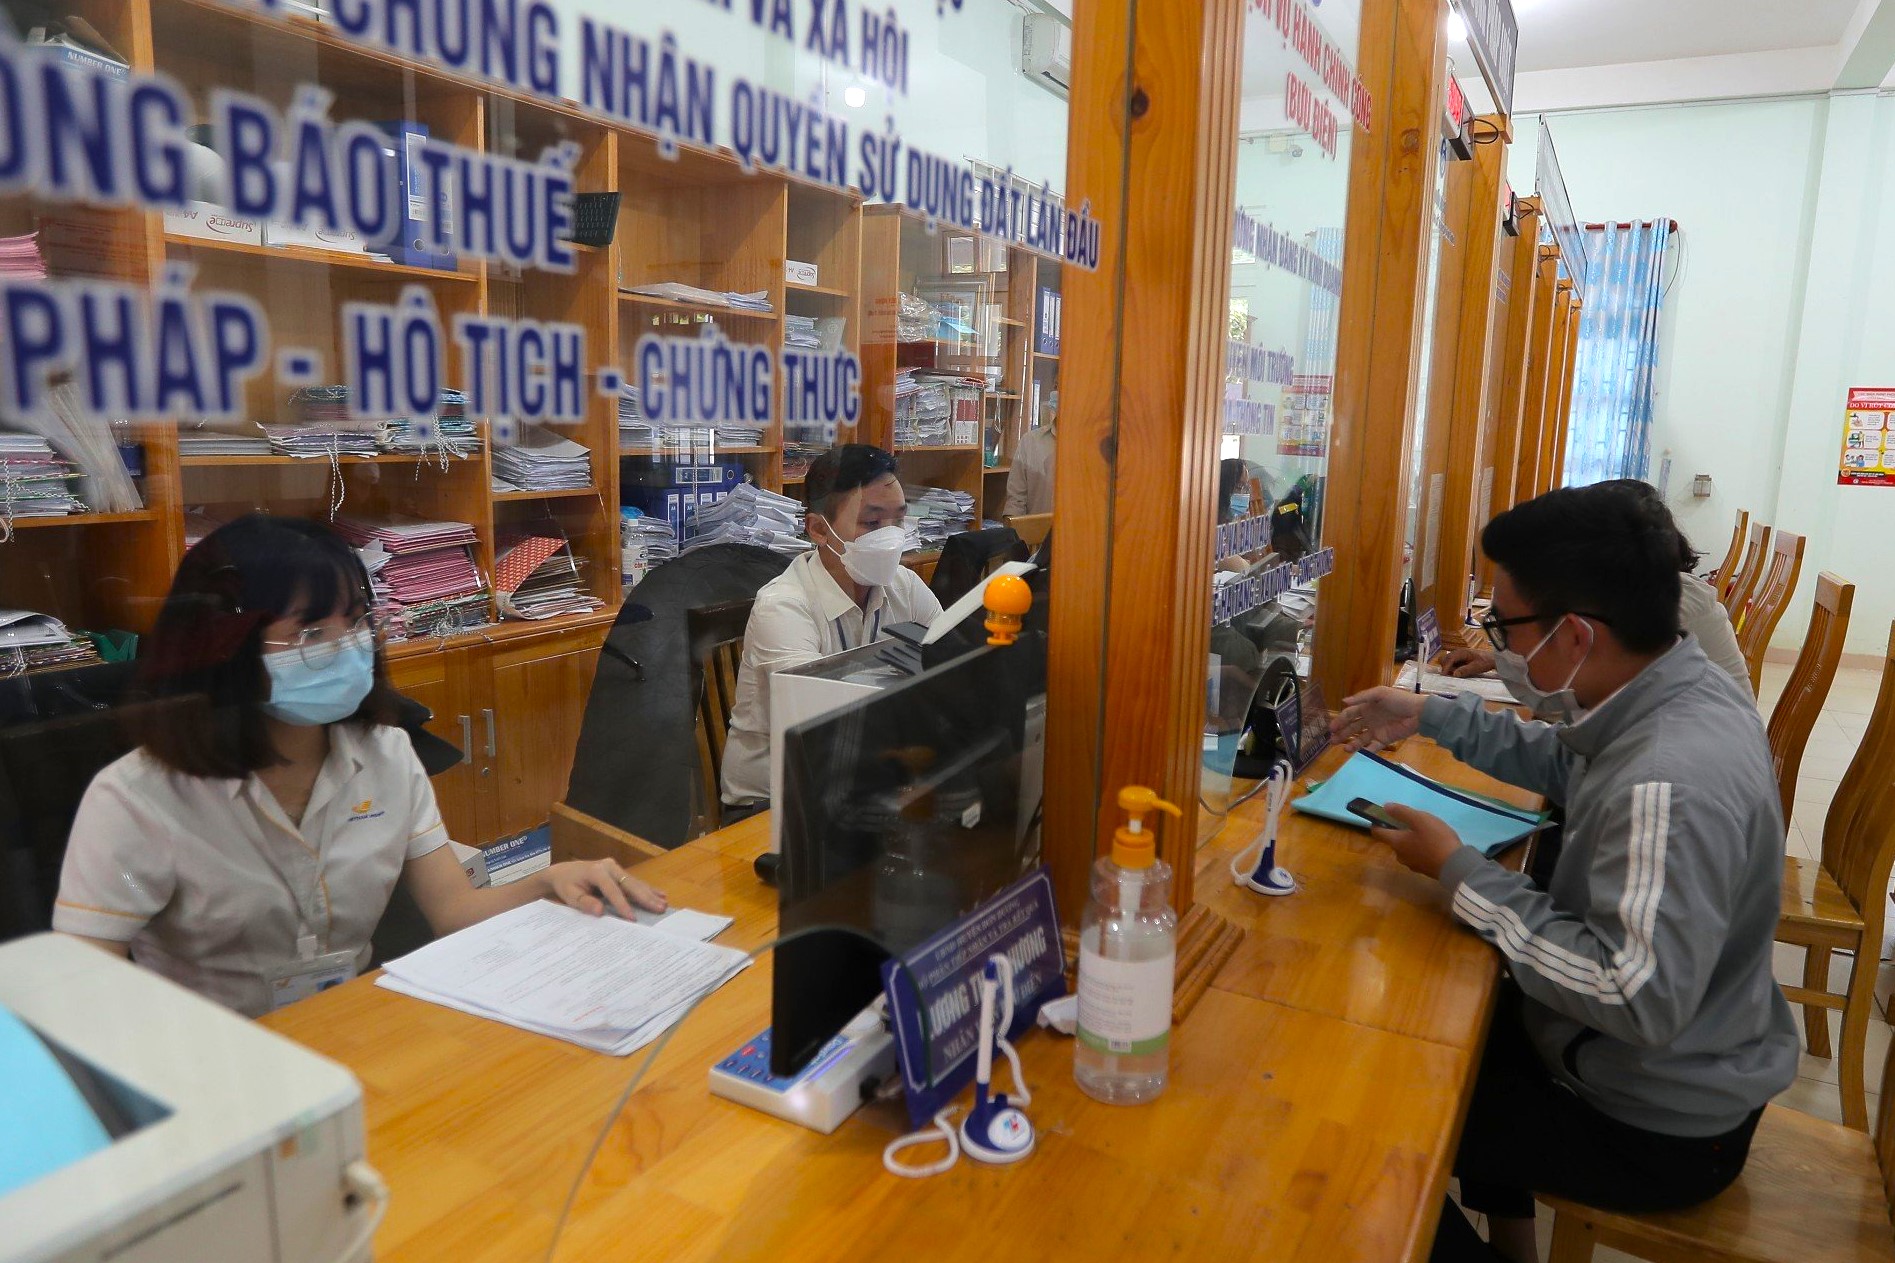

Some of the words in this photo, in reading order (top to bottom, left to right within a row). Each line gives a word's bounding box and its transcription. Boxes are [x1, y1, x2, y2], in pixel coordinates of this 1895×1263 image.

[582, 18, 714, 152] NHẬN
[730, 78, 846, 188] QUYỀN
[859, 112, 901, 204] SỬ
[906, 146, 974, 232] DỤNG
[208, 216, 254, 234] Supreme
[419, 143, 574, 266] THUẾ
[5, 270, 259, 413] PHÁP
[355, 294, 438, 437] HỘ
[463, 323, 582, 437] TỊCH
[641, 327, 770, 421] CHỨNG
[783, 348, 859, 438] THỰC
